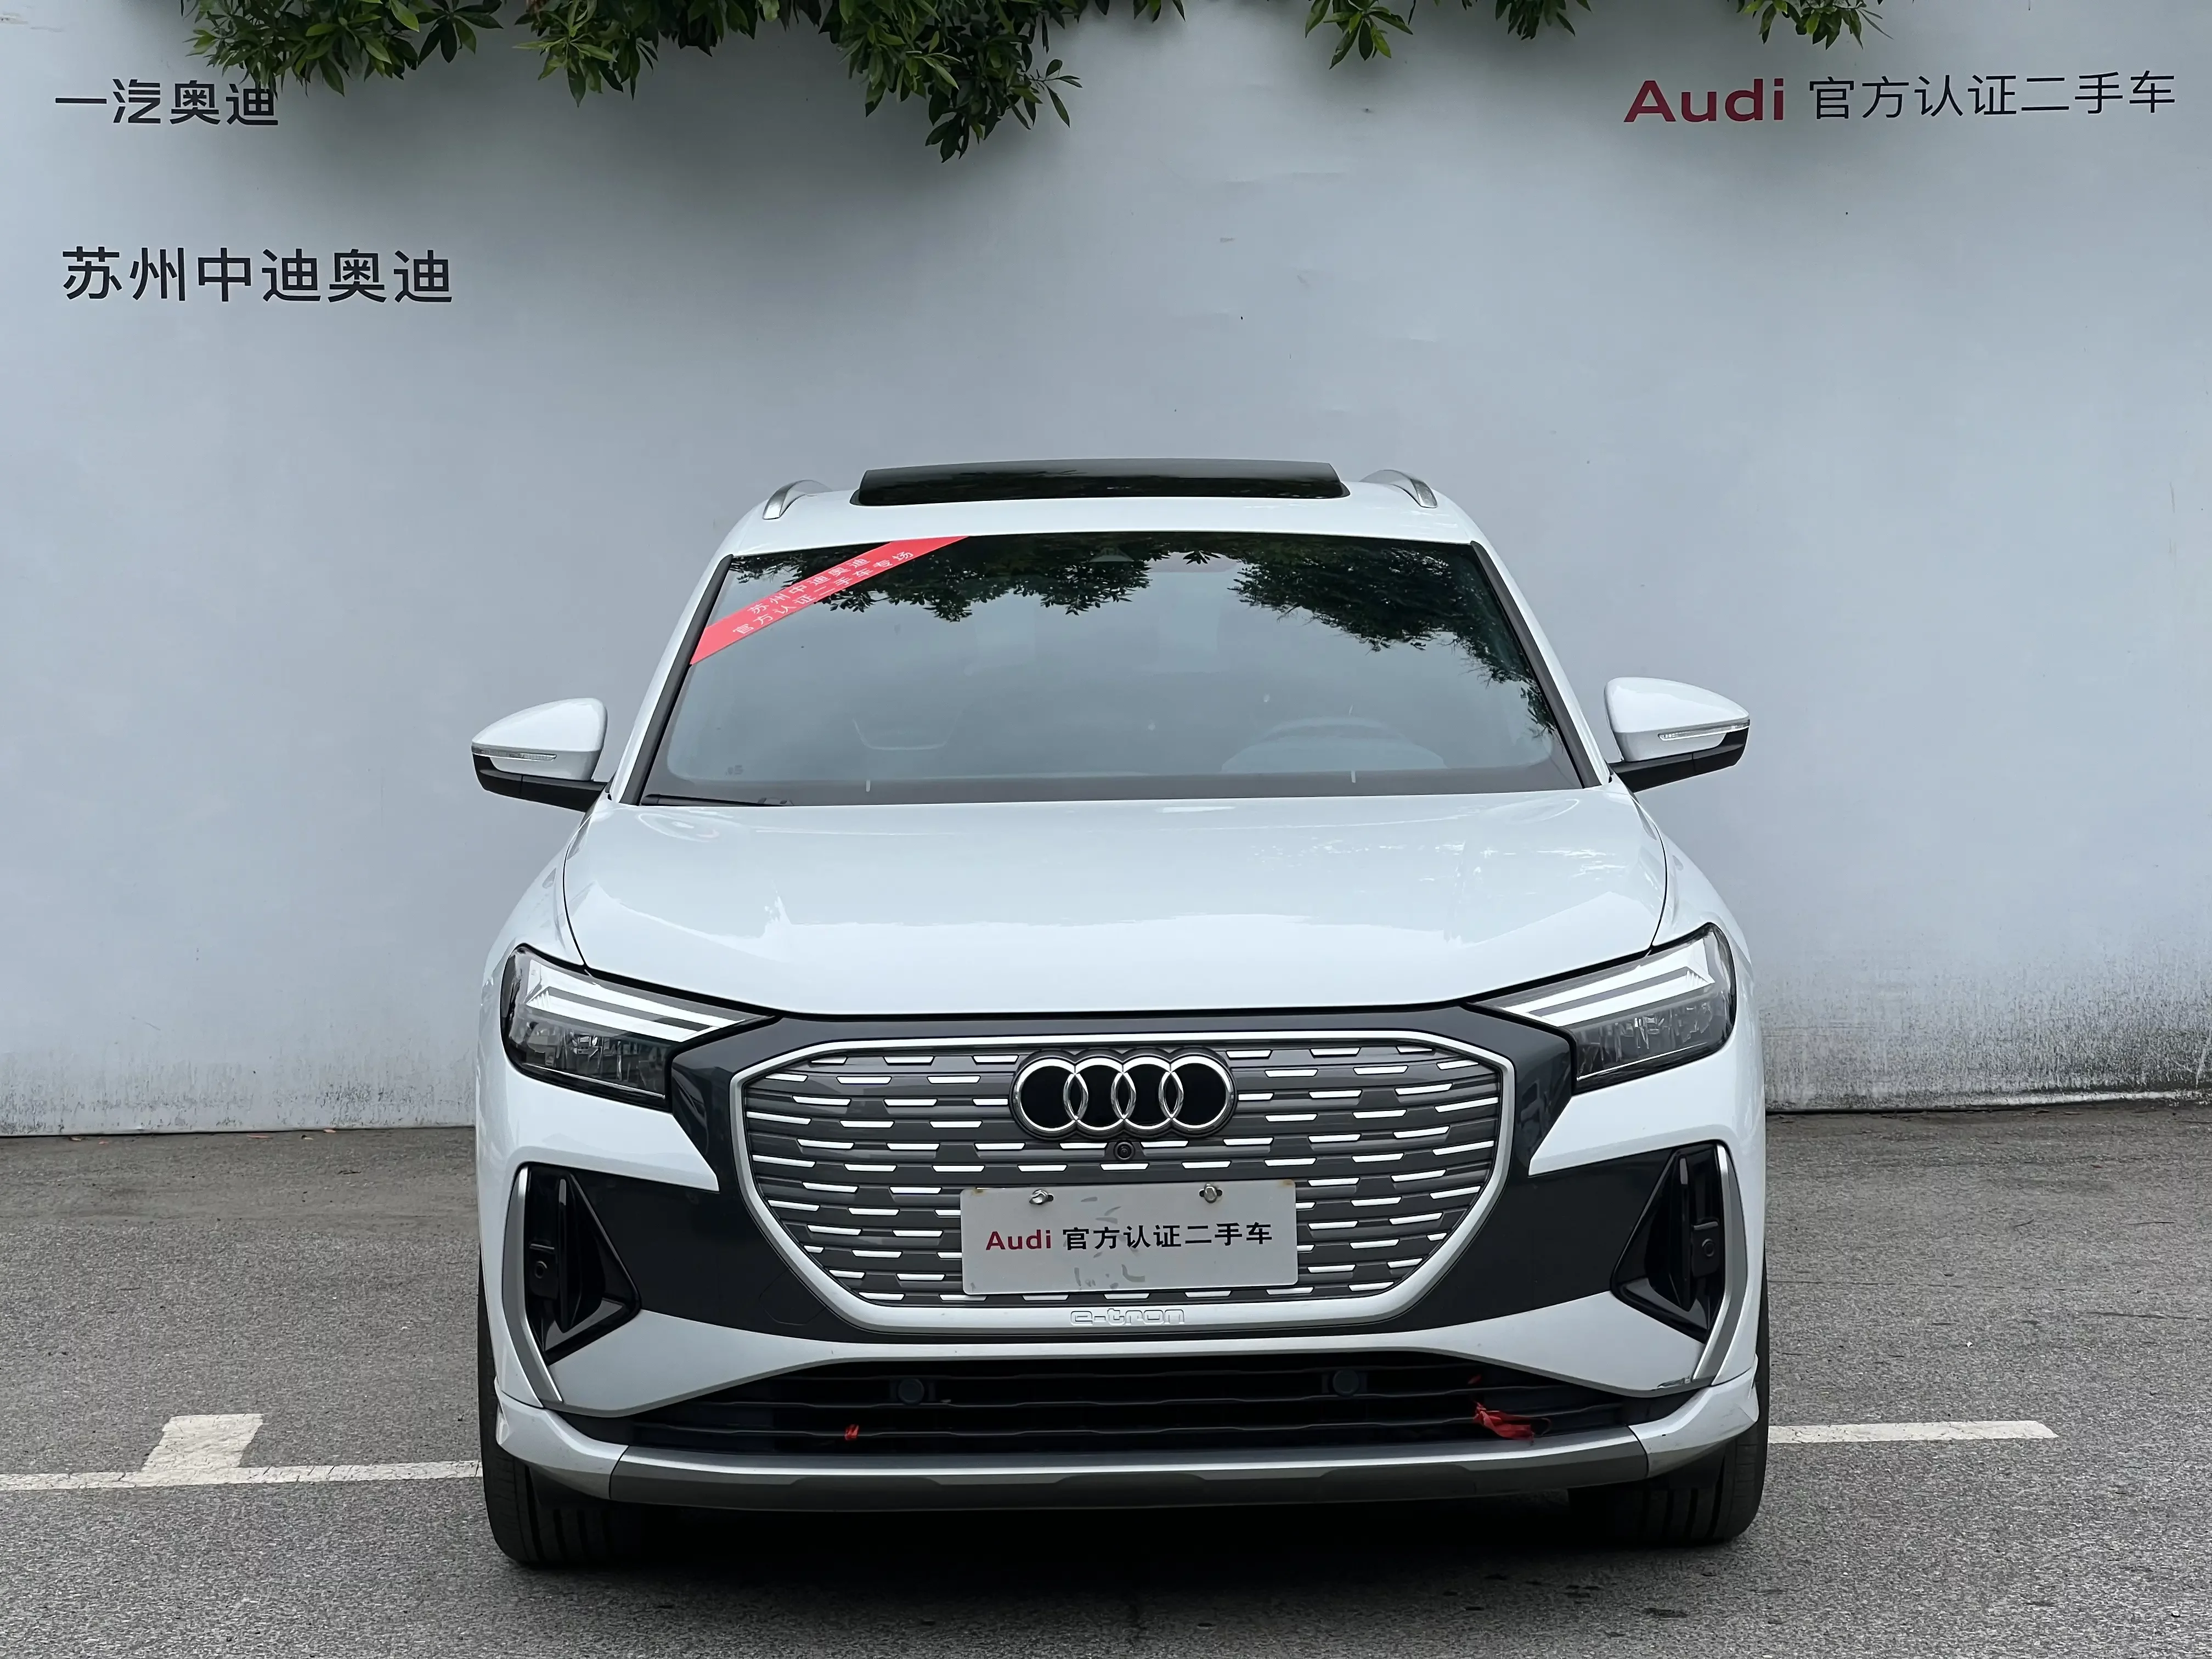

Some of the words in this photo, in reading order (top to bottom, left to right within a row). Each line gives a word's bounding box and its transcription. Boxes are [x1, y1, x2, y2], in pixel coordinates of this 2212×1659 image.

[55, 78, 279, 125] 一汽奥迪
[1623, 78, 1784, 122] Audi
[1809, 69, 2176, 119] 官方认证二手车
[62, 246, 453, 303] 苏州中迪奥迪
[732, 551, 914, 634] 官方认证二手车专场
[747, 558, 870, 614] 苏州中迪奥迪
[985, 1229, 1052, 1251] Audi
[1062, 1221, 1273, 1251] 官方认证二手车
[1070, 1308, 1185, 1326] e-tron
